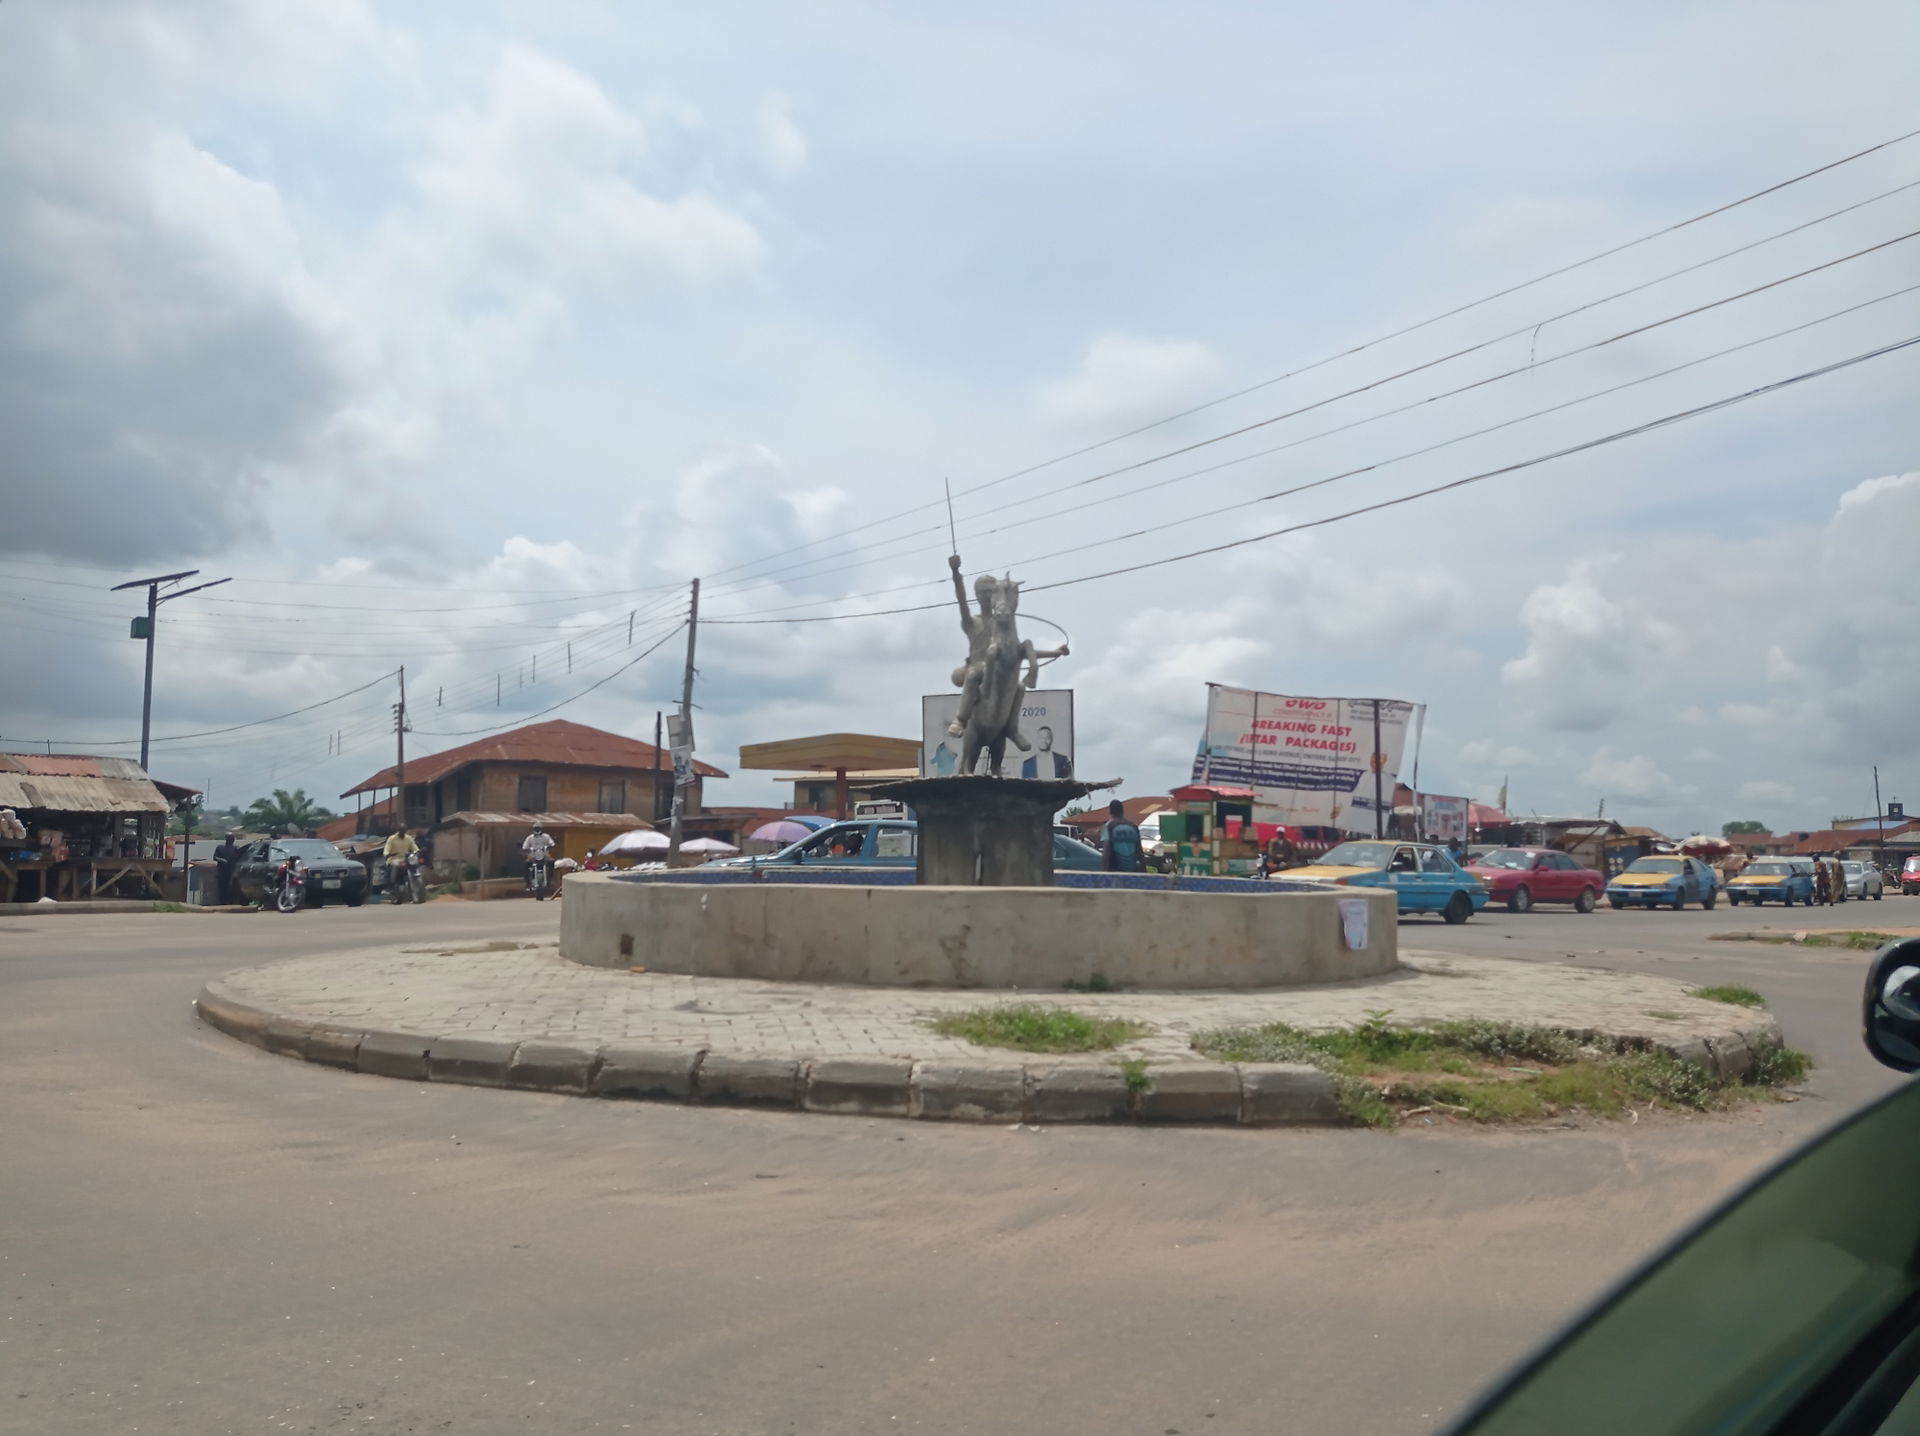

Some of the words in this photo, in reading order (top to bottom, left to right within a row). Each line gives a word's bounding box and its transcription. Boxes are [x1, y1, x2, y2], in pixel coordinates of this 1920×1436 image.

[1022, 706, 1047, 717] 2020
[1285, 699, 1327, 710] OWO
[1251, 720, 1317, 733] BREAKING
[1321, 725, 1352, 737] FAST
[1285, 736, 1357, 753] PACKAGES)
